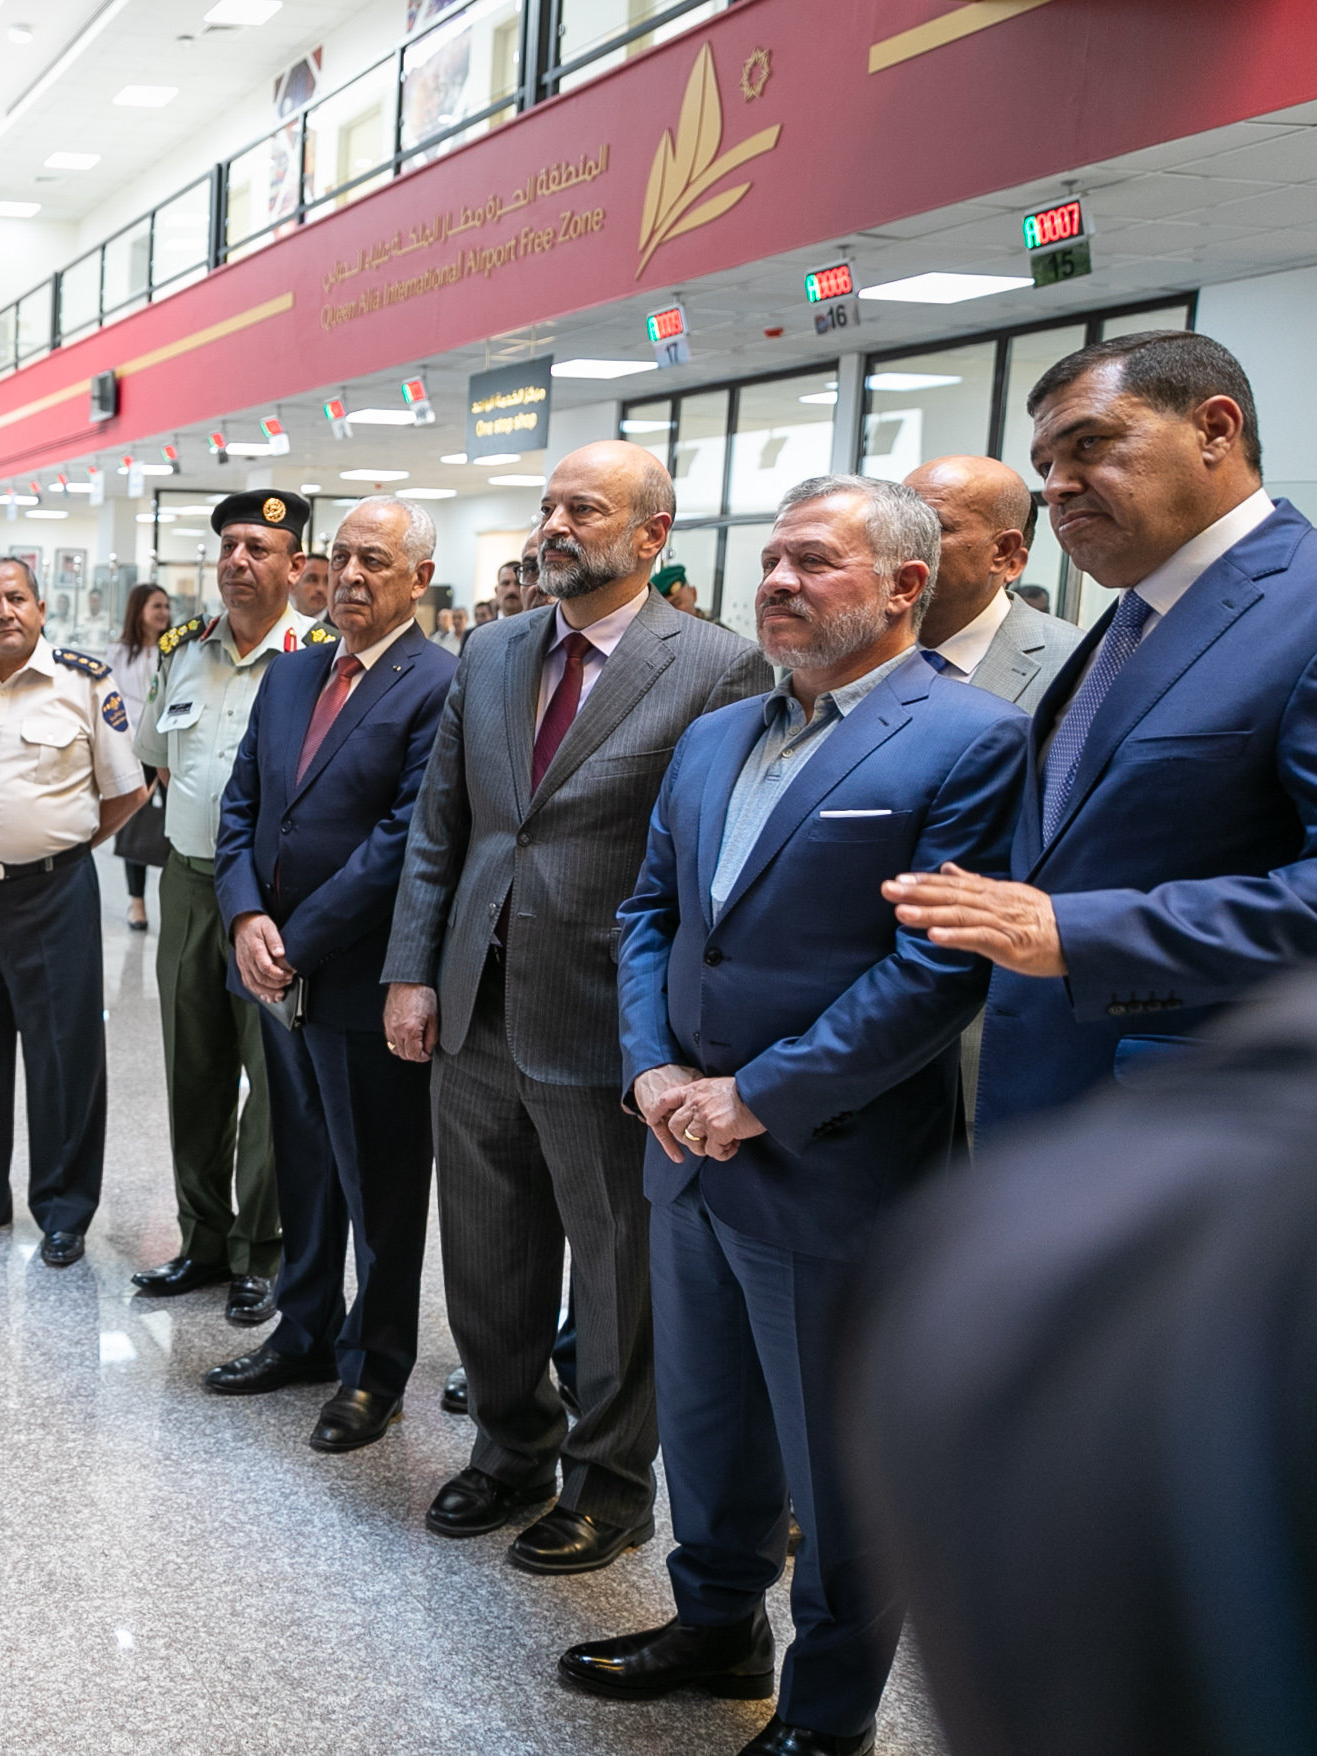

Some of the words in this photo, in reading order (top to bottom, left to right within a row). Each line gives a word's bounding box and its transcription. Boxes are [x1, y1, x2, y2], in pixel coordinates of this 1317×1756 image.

[1023, 202, 1079, 249] A0007
[321, 300, 358, 332] Queen
[384, 249, 464, 307] International
[465, 234, 518, 278] Airport
[520, 226, 555, 257] Free
[558, 206, 606, 242] Zone
[1047, 249, 1075, 280] 15
[826, 304, 848, 329] 16
[475, 419, 494, 438] One
[493, 417, 514, 435] stop
